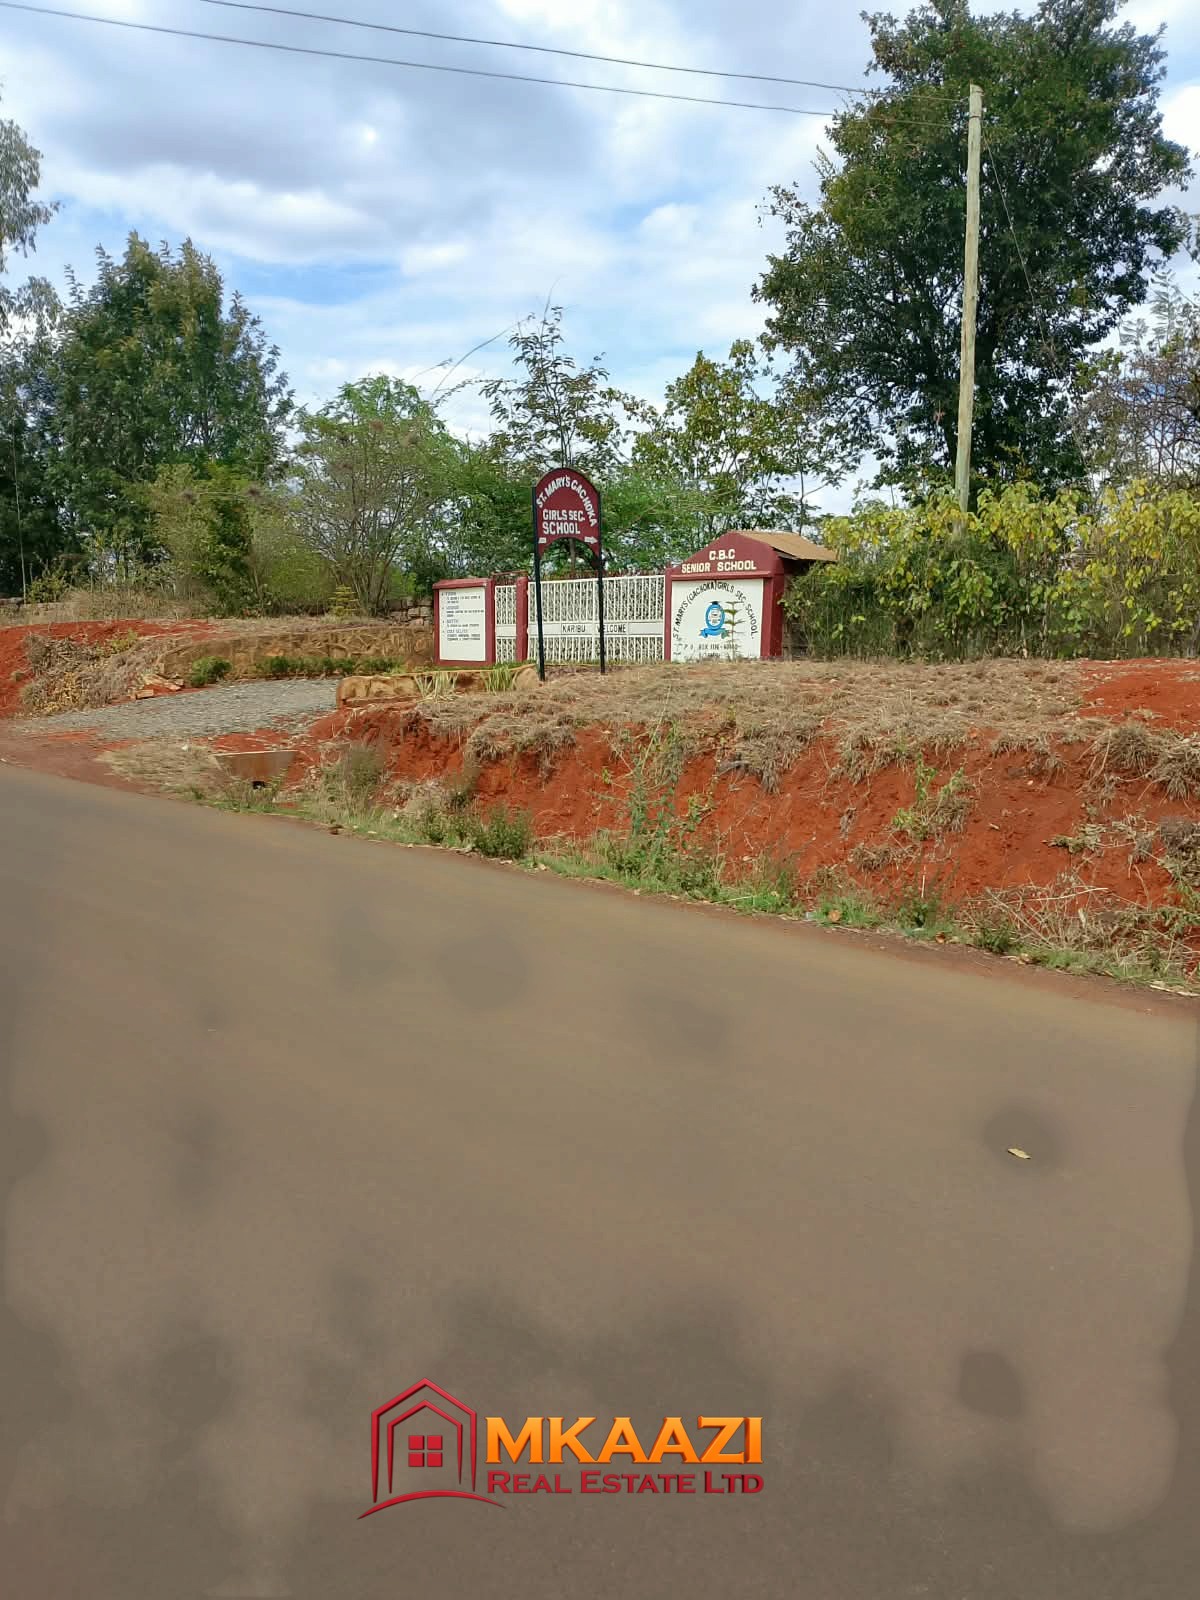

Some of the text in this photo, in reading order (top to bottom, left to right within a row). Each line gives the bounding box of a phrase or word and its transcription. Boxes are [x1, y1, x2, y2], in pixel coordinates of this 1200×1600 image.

[545, 475, 570, 497] MARY'S
[571, 480, 597, 527] GACHOKA
[543, 509, 567, 520] GIRLS
[542, 522, 580, 534] SCHOOL
[709, 548, 736, 560] C.B.C
[682, 560, 757, 574] SENIOR SCHOOL
[718, 582, 734, 593] GIRLS
[562, 624, 586, 633] KARIBU
